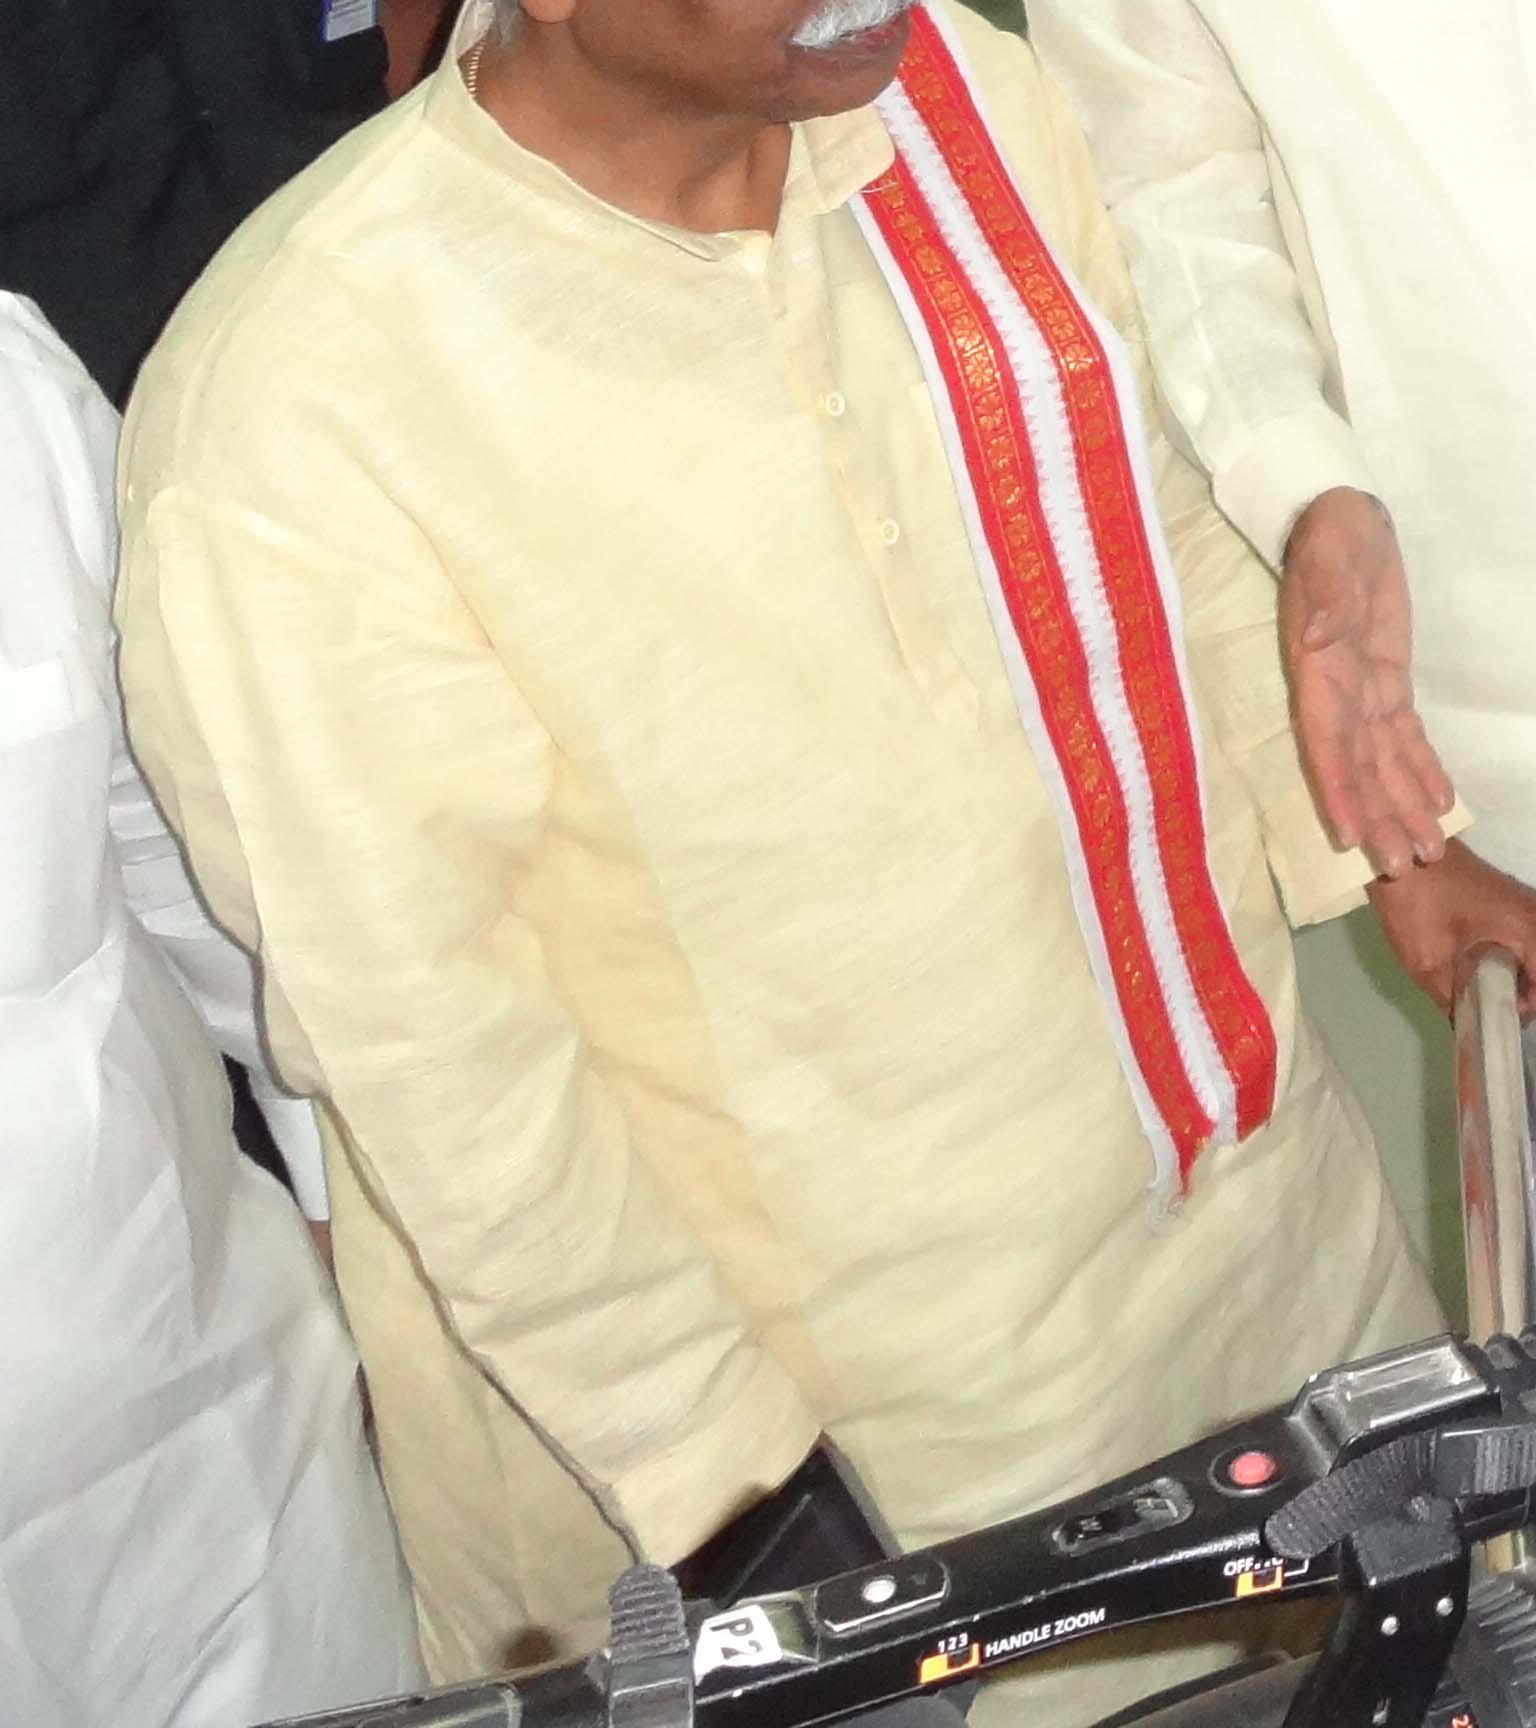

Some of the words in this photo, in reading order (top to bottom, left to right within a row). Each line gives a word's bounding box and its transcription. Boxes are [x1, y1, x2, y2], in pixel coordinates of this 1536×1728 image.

[1223, 1556, 1254, 1576] OFF
[708, 1616, 763, 1661] P2
[985, 1624, 1051, 1658] HANDLE
[1053, 1607, 1106, 1636] ZOOM
